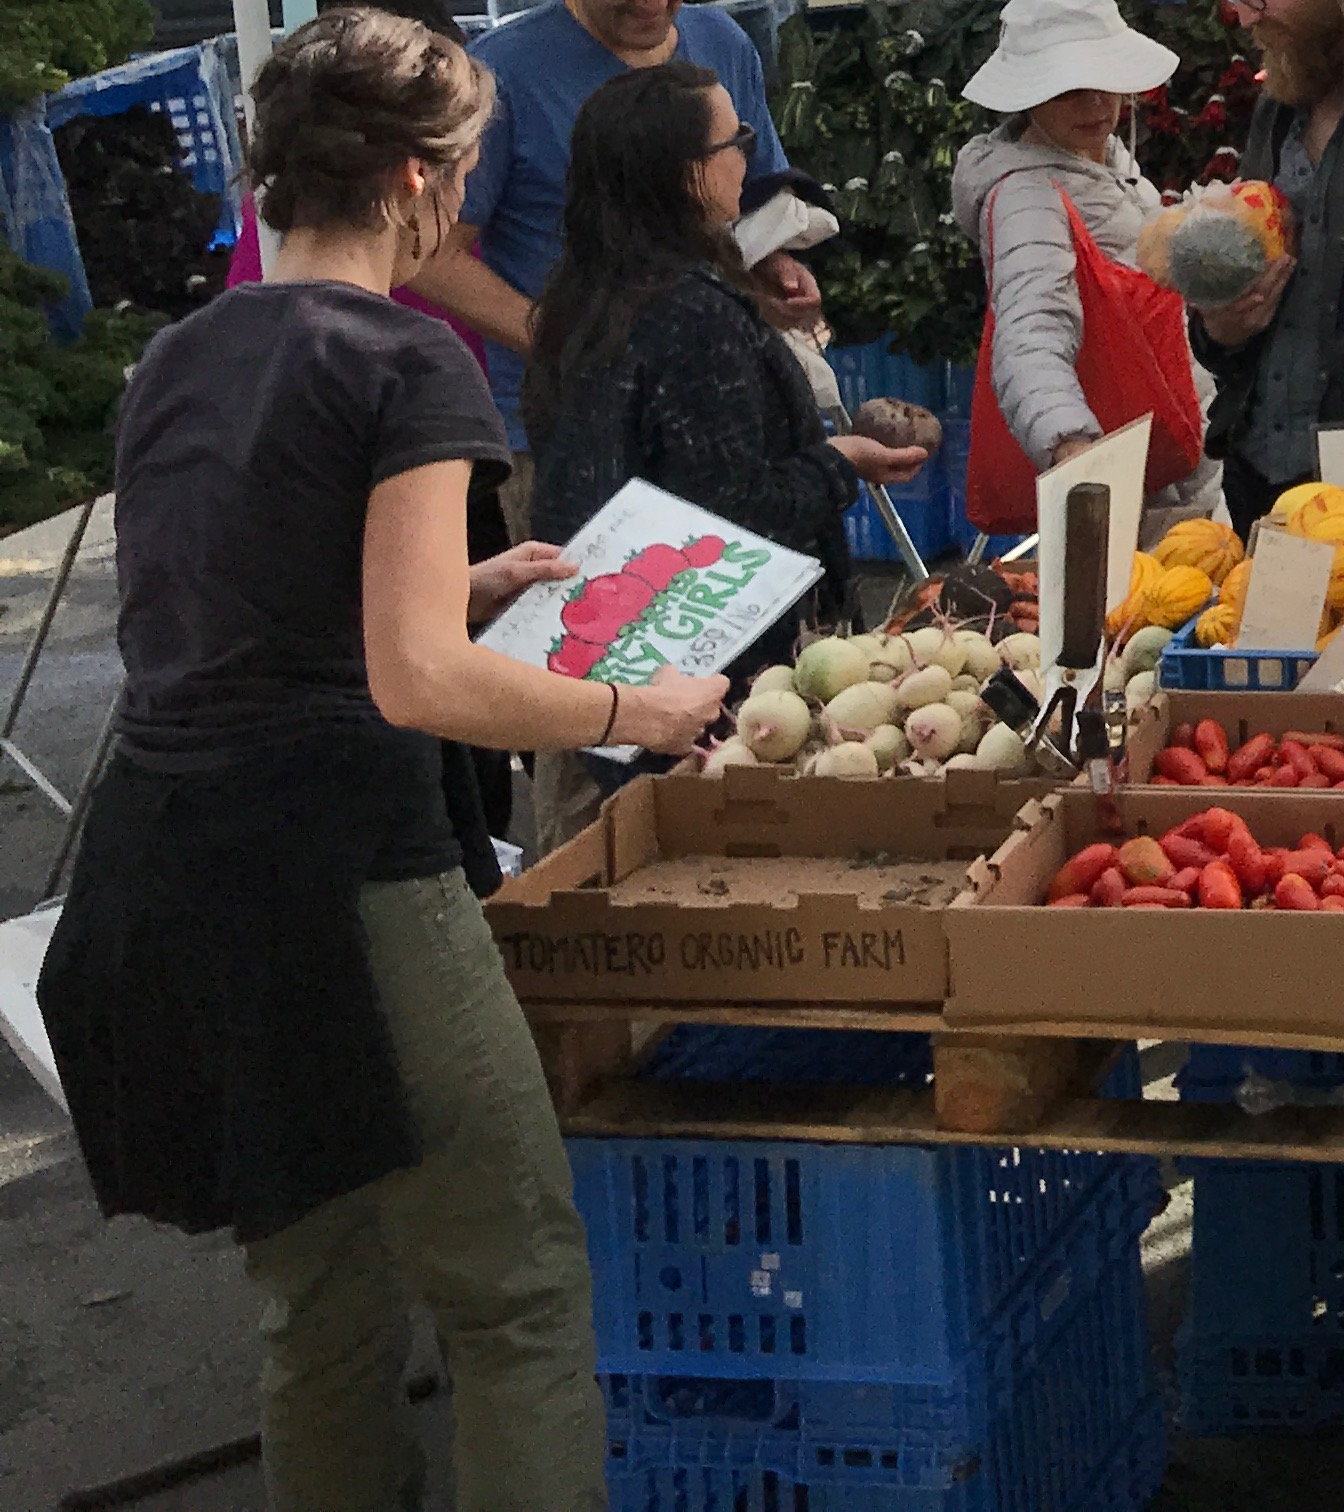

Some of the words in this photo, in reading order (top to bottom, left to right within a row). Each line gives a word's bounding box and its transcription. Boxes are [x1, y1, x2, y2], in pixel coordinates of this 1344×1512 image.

[654, 540, 772, 640] GIRLS
[502, 930, 667, 975] TOMATERO
[680, 926, 805, 972] ORGANIC
[821, 929, 907, 971] FARM
